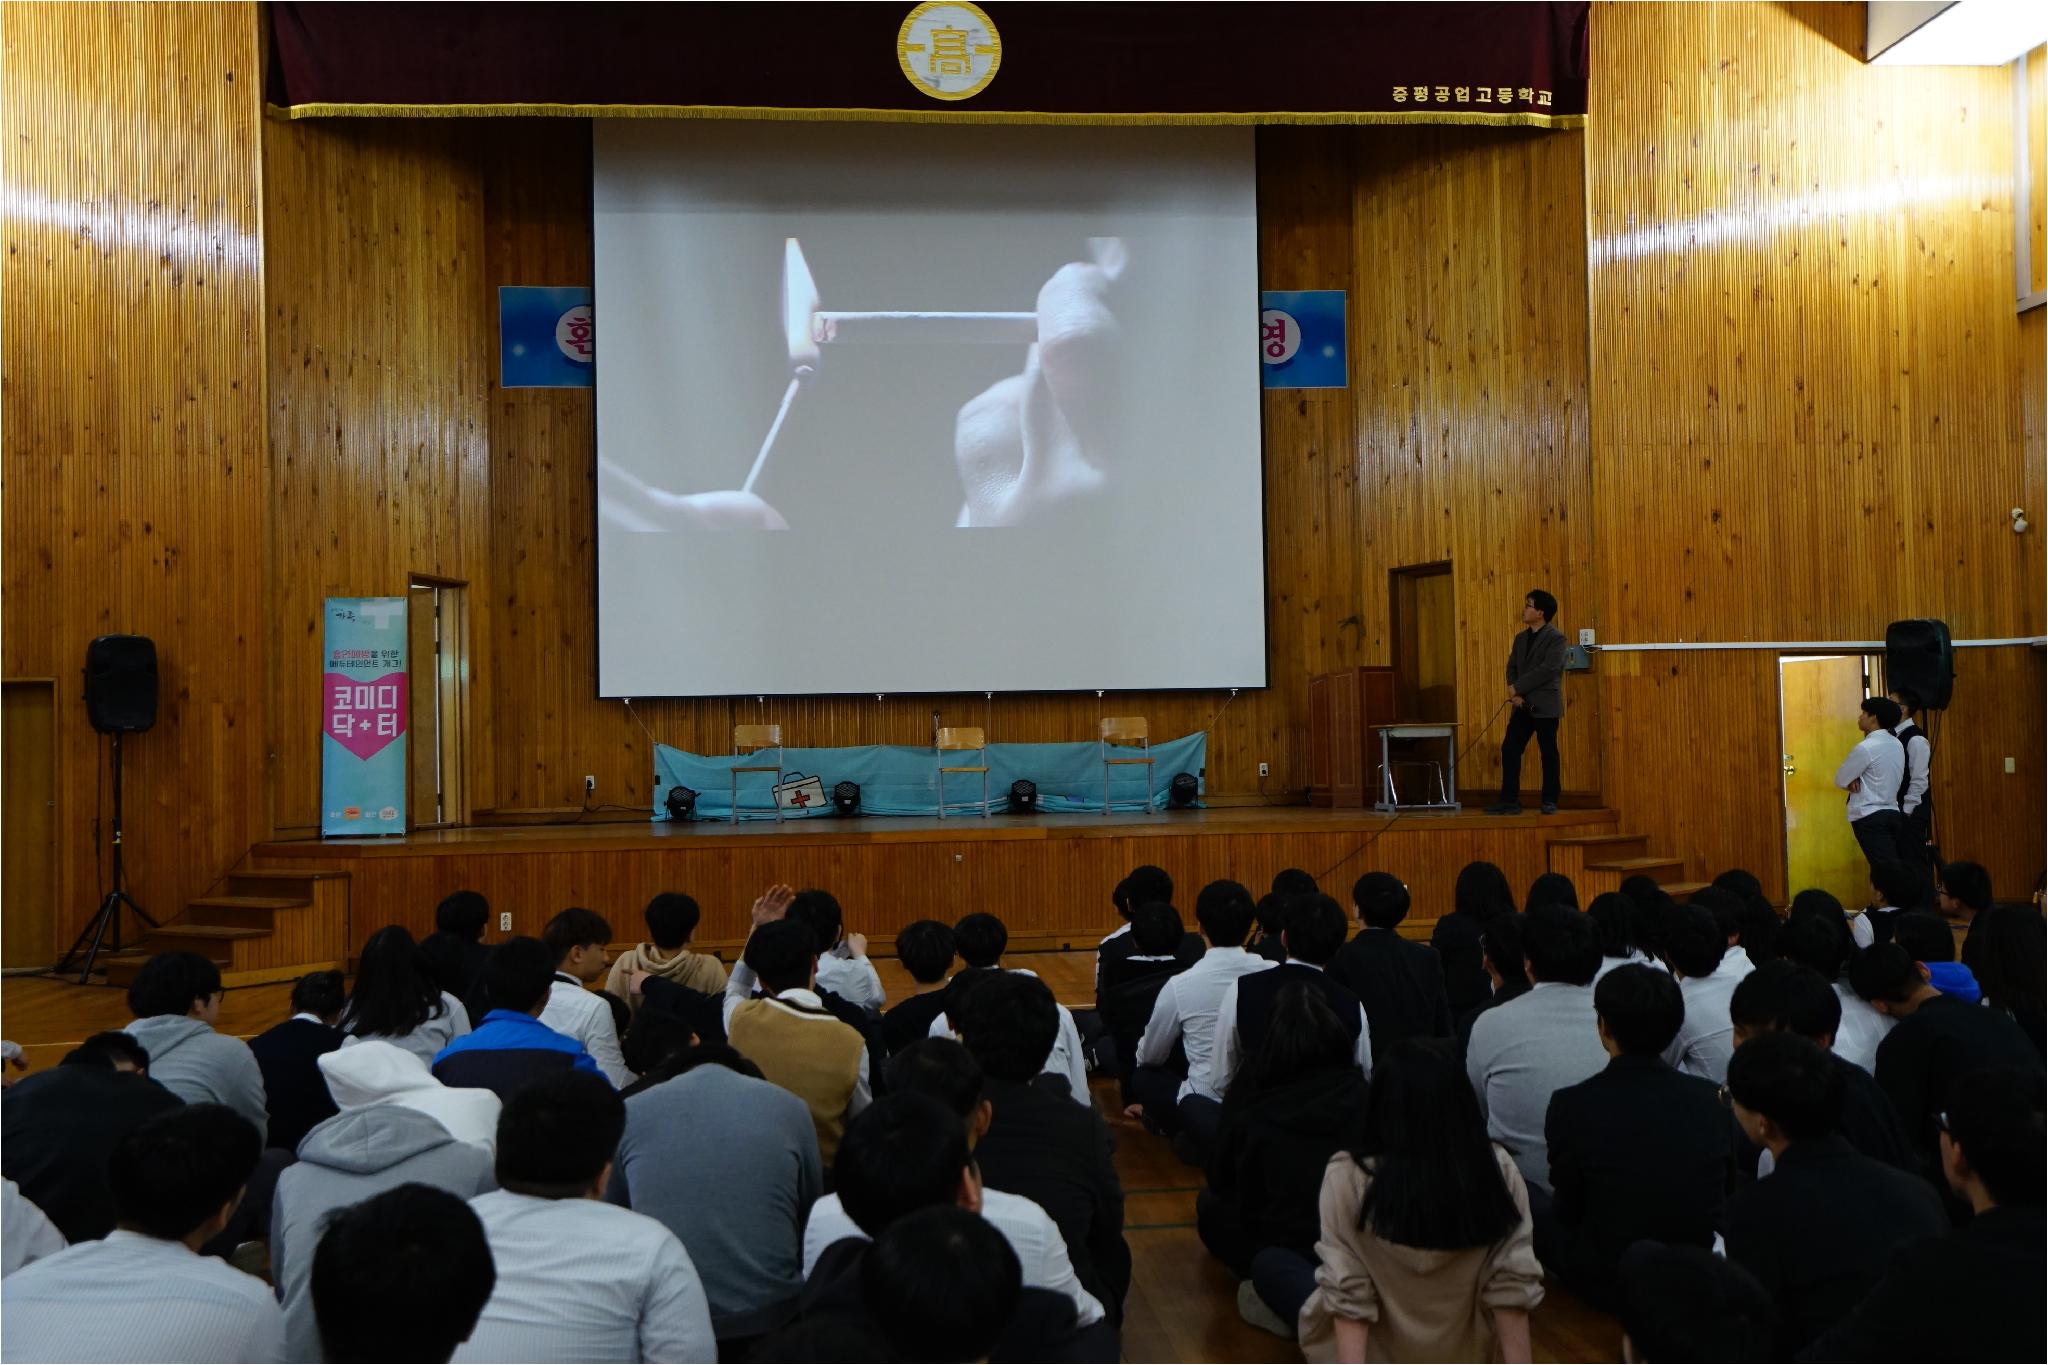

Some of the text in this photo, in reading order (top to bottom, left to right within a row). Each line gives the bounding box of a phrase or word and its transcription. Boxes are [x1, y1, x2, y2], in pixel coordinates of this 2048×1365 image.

[1392, 85, 1553, 106] 증평공업고등학교
[381, 649, 400, 659] 위한
[333, 685, 397, 710] 코미디
